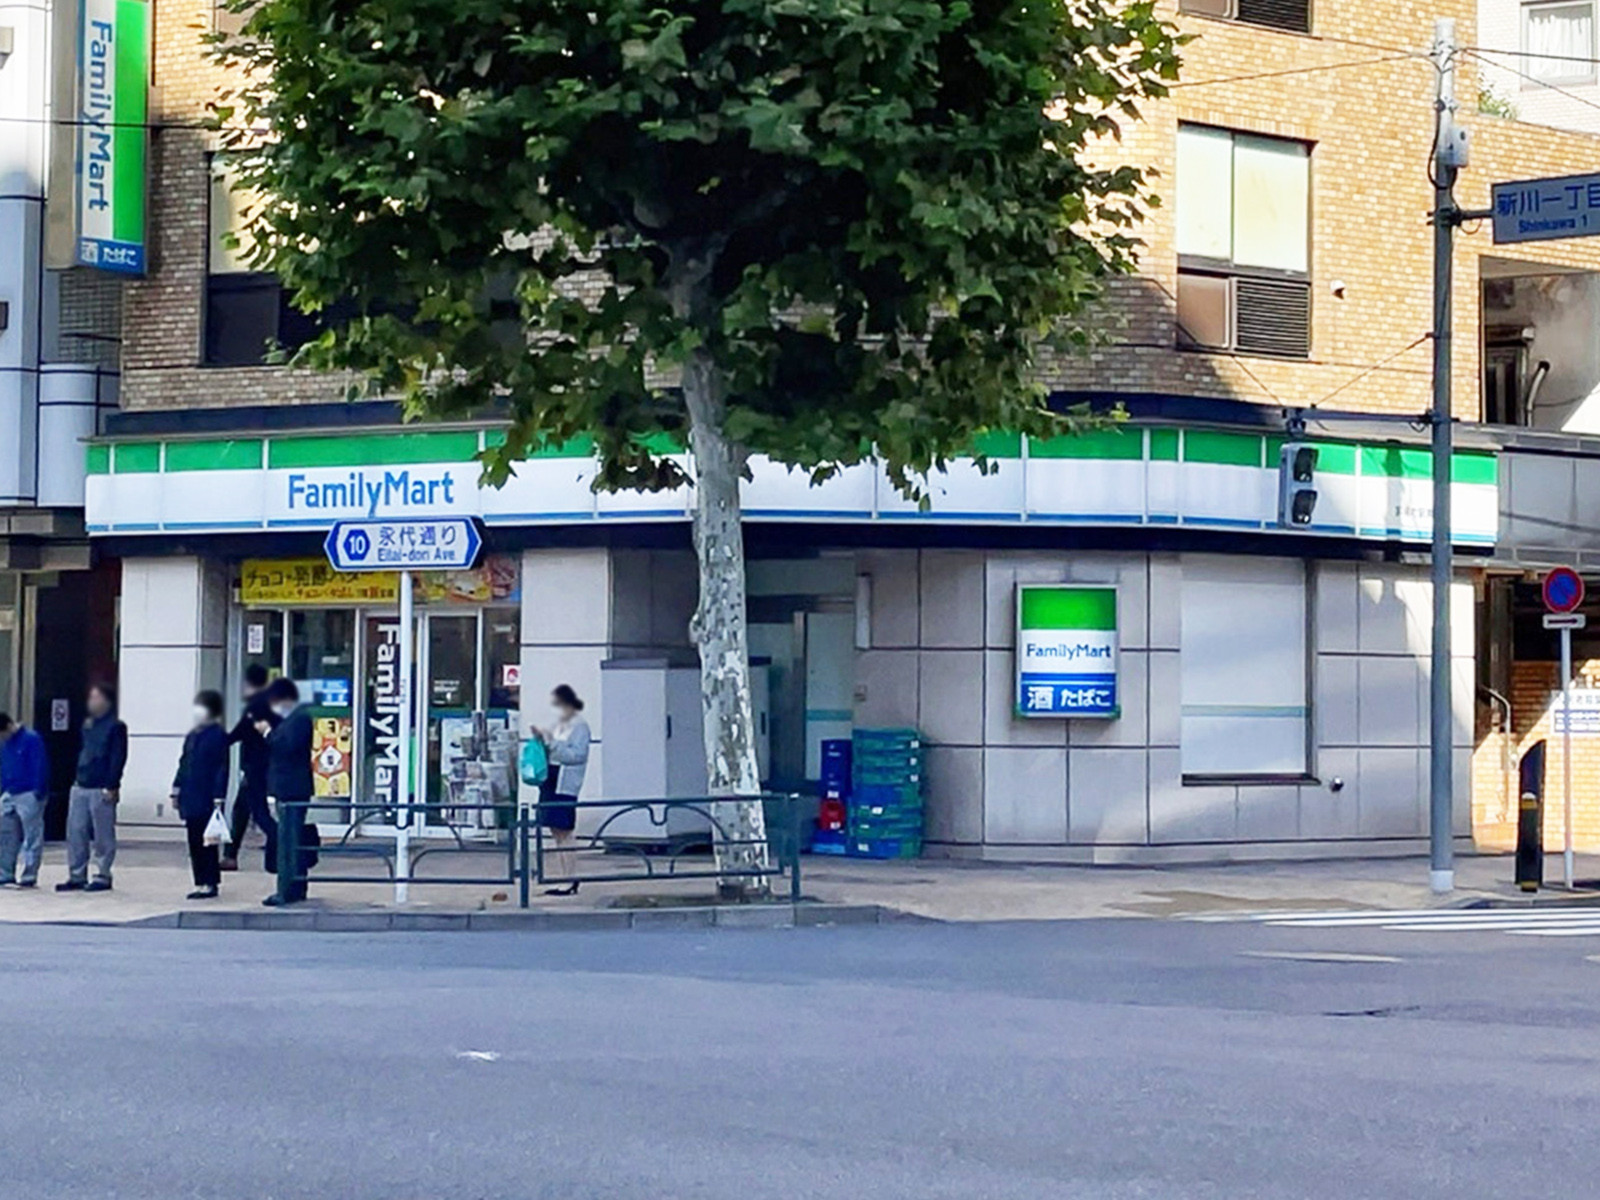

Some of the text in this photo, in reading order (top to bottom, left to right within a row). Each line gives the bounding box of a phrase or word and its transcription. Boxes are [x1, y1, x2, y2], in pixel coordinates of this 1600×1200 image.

[82, 20, 112, 211] FamilyMart
[1497, 183, 1600, 217] 新川一丁目
[1581, 214, 1587, 227] 1
[103, 247, 137, 266] たばこ
[289, 471, 454, 518] FamilyMart
[349, 535, 366, 555] 10
[379, 525, 456, 546] 永代通り
[1026, 643, 1112, 660] FamilyMart
[1027, 686, 1111, 709] 酒 たばこ
[369, 624, 401, 816] FamilyMar
